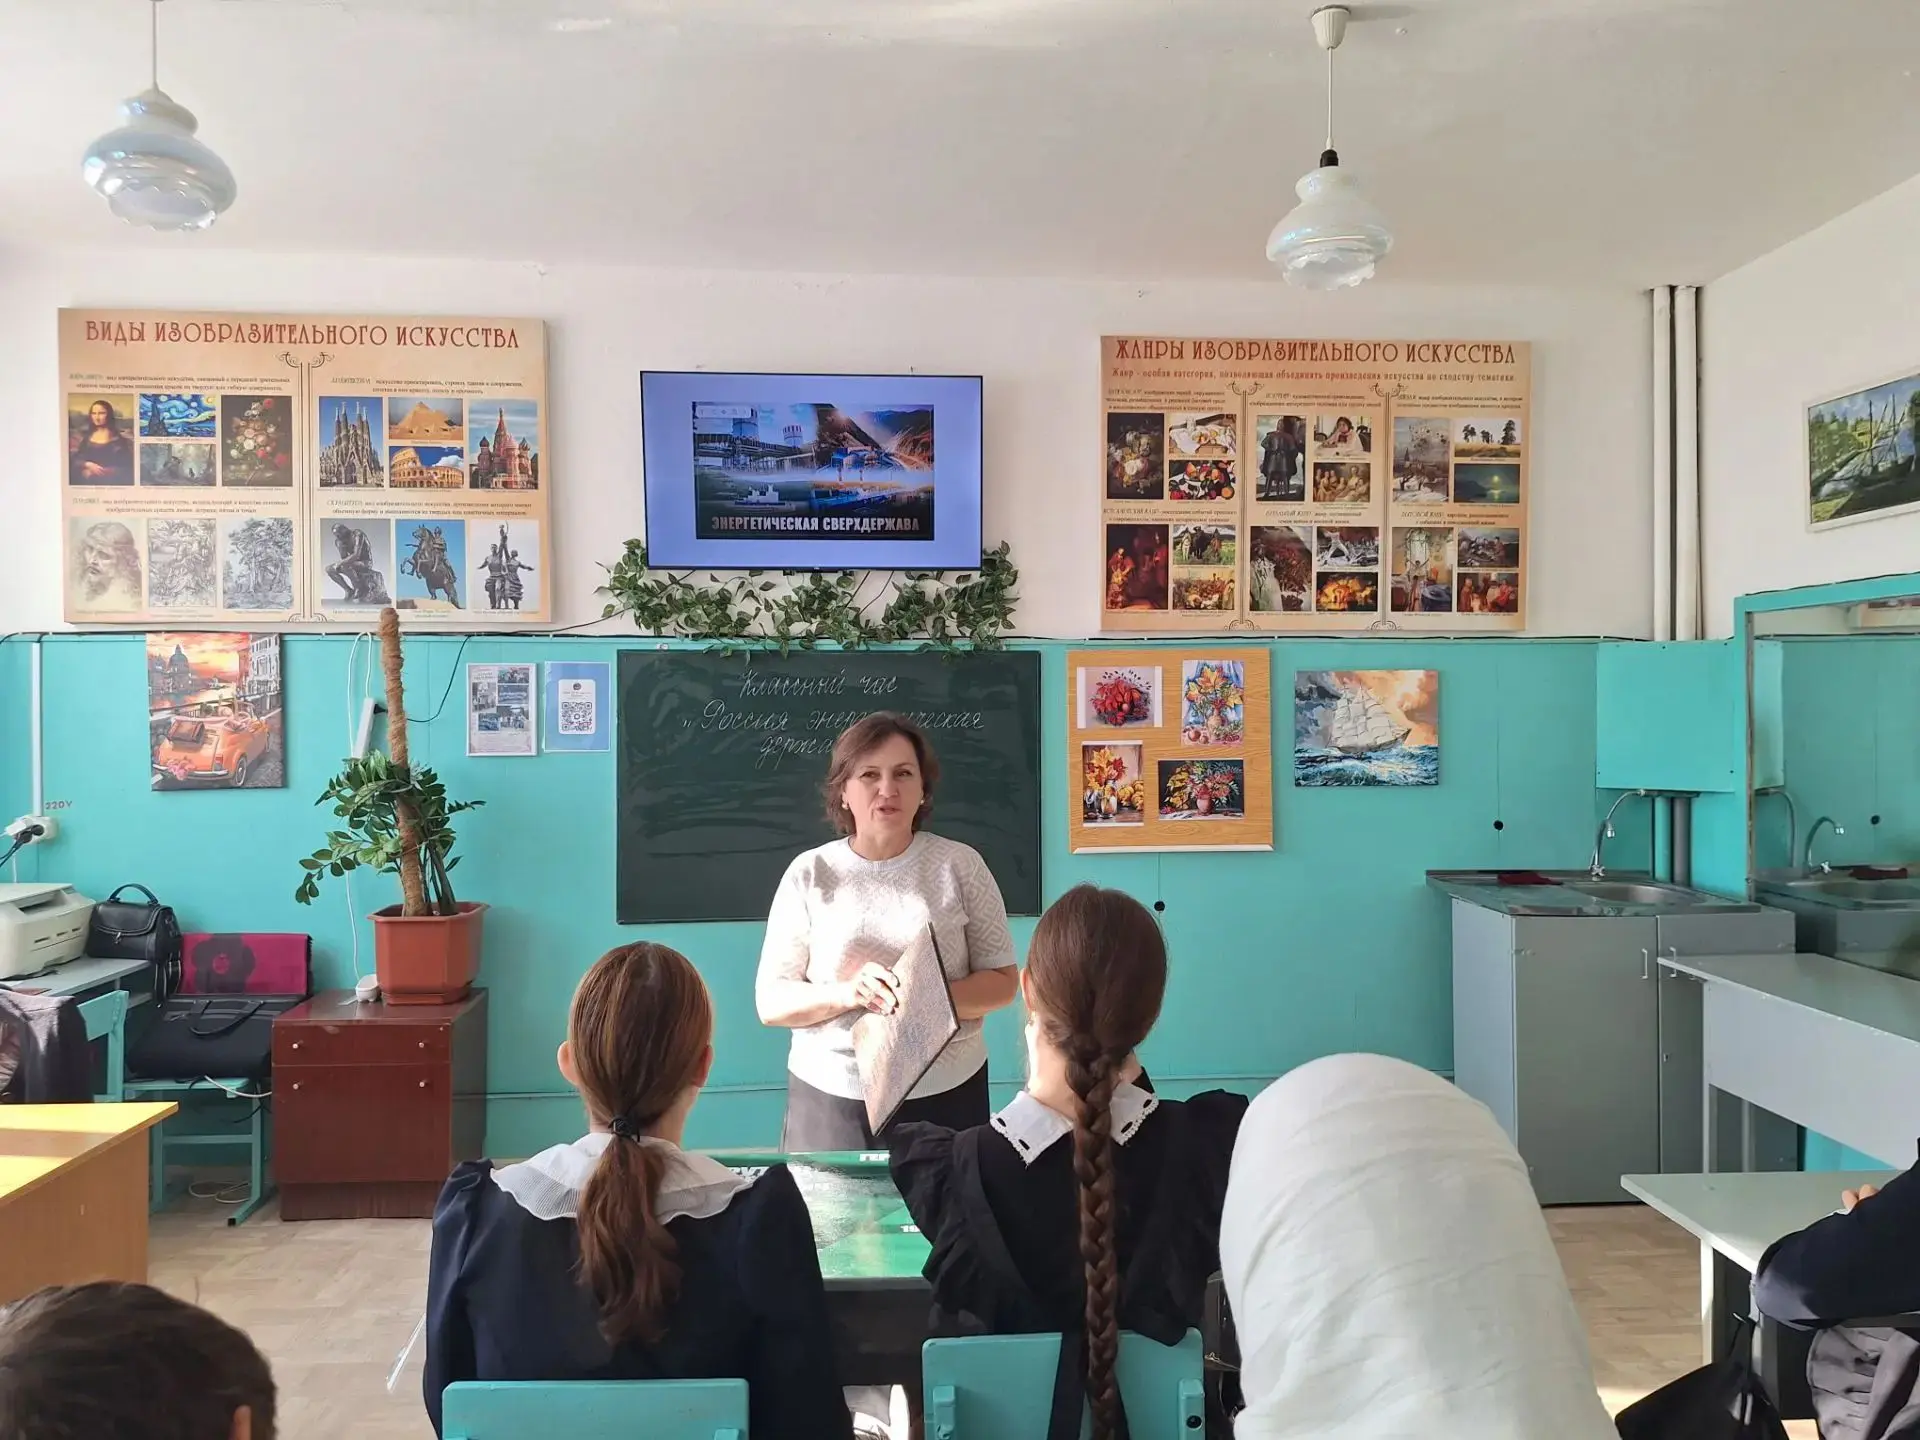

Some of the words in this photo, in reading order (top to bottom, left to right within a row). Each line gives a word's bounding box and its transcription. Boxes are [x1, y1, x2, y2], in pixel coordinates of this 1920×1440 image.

[86, 320, 146, 346] ВИДЫ
[155, 322, 387, 346] ИЗОБРАЗИТЕЛЬНОГО
[396, 326, 520, 349] ИСКУССТВА
[1115, 339, 1185, 360] ЖАНРЫ
[1192, 340, 1399, 363] ИЗОБРАЗИТЕЛЬНОГО
[1406, 343, 1516, 364] ИСКУССТВА
[1112, 367, 1134, 379] Жанр
[1142, 368, 1171, 378] особая
[1173, 371, 1217, 381] категория,
[1219, 371, 1273, 380] позволяющая
[1325, 371, 1381, 382] произведения
[1384, 372, 1424, 381] искусства
[1439, 373, 1475, 383] сходству
[1477, 374, 1515, 382] тематики
[711, 516, 819, 531] ЭНЕРГЕТИЧЕСКАЯ
[823, 516, 920, 533] СВЕРХДЕРЖАВА
[739, 668, 846, 698] Классный
[859, 674, 898, 695] час
[45, 800, 73, 810] 220V
